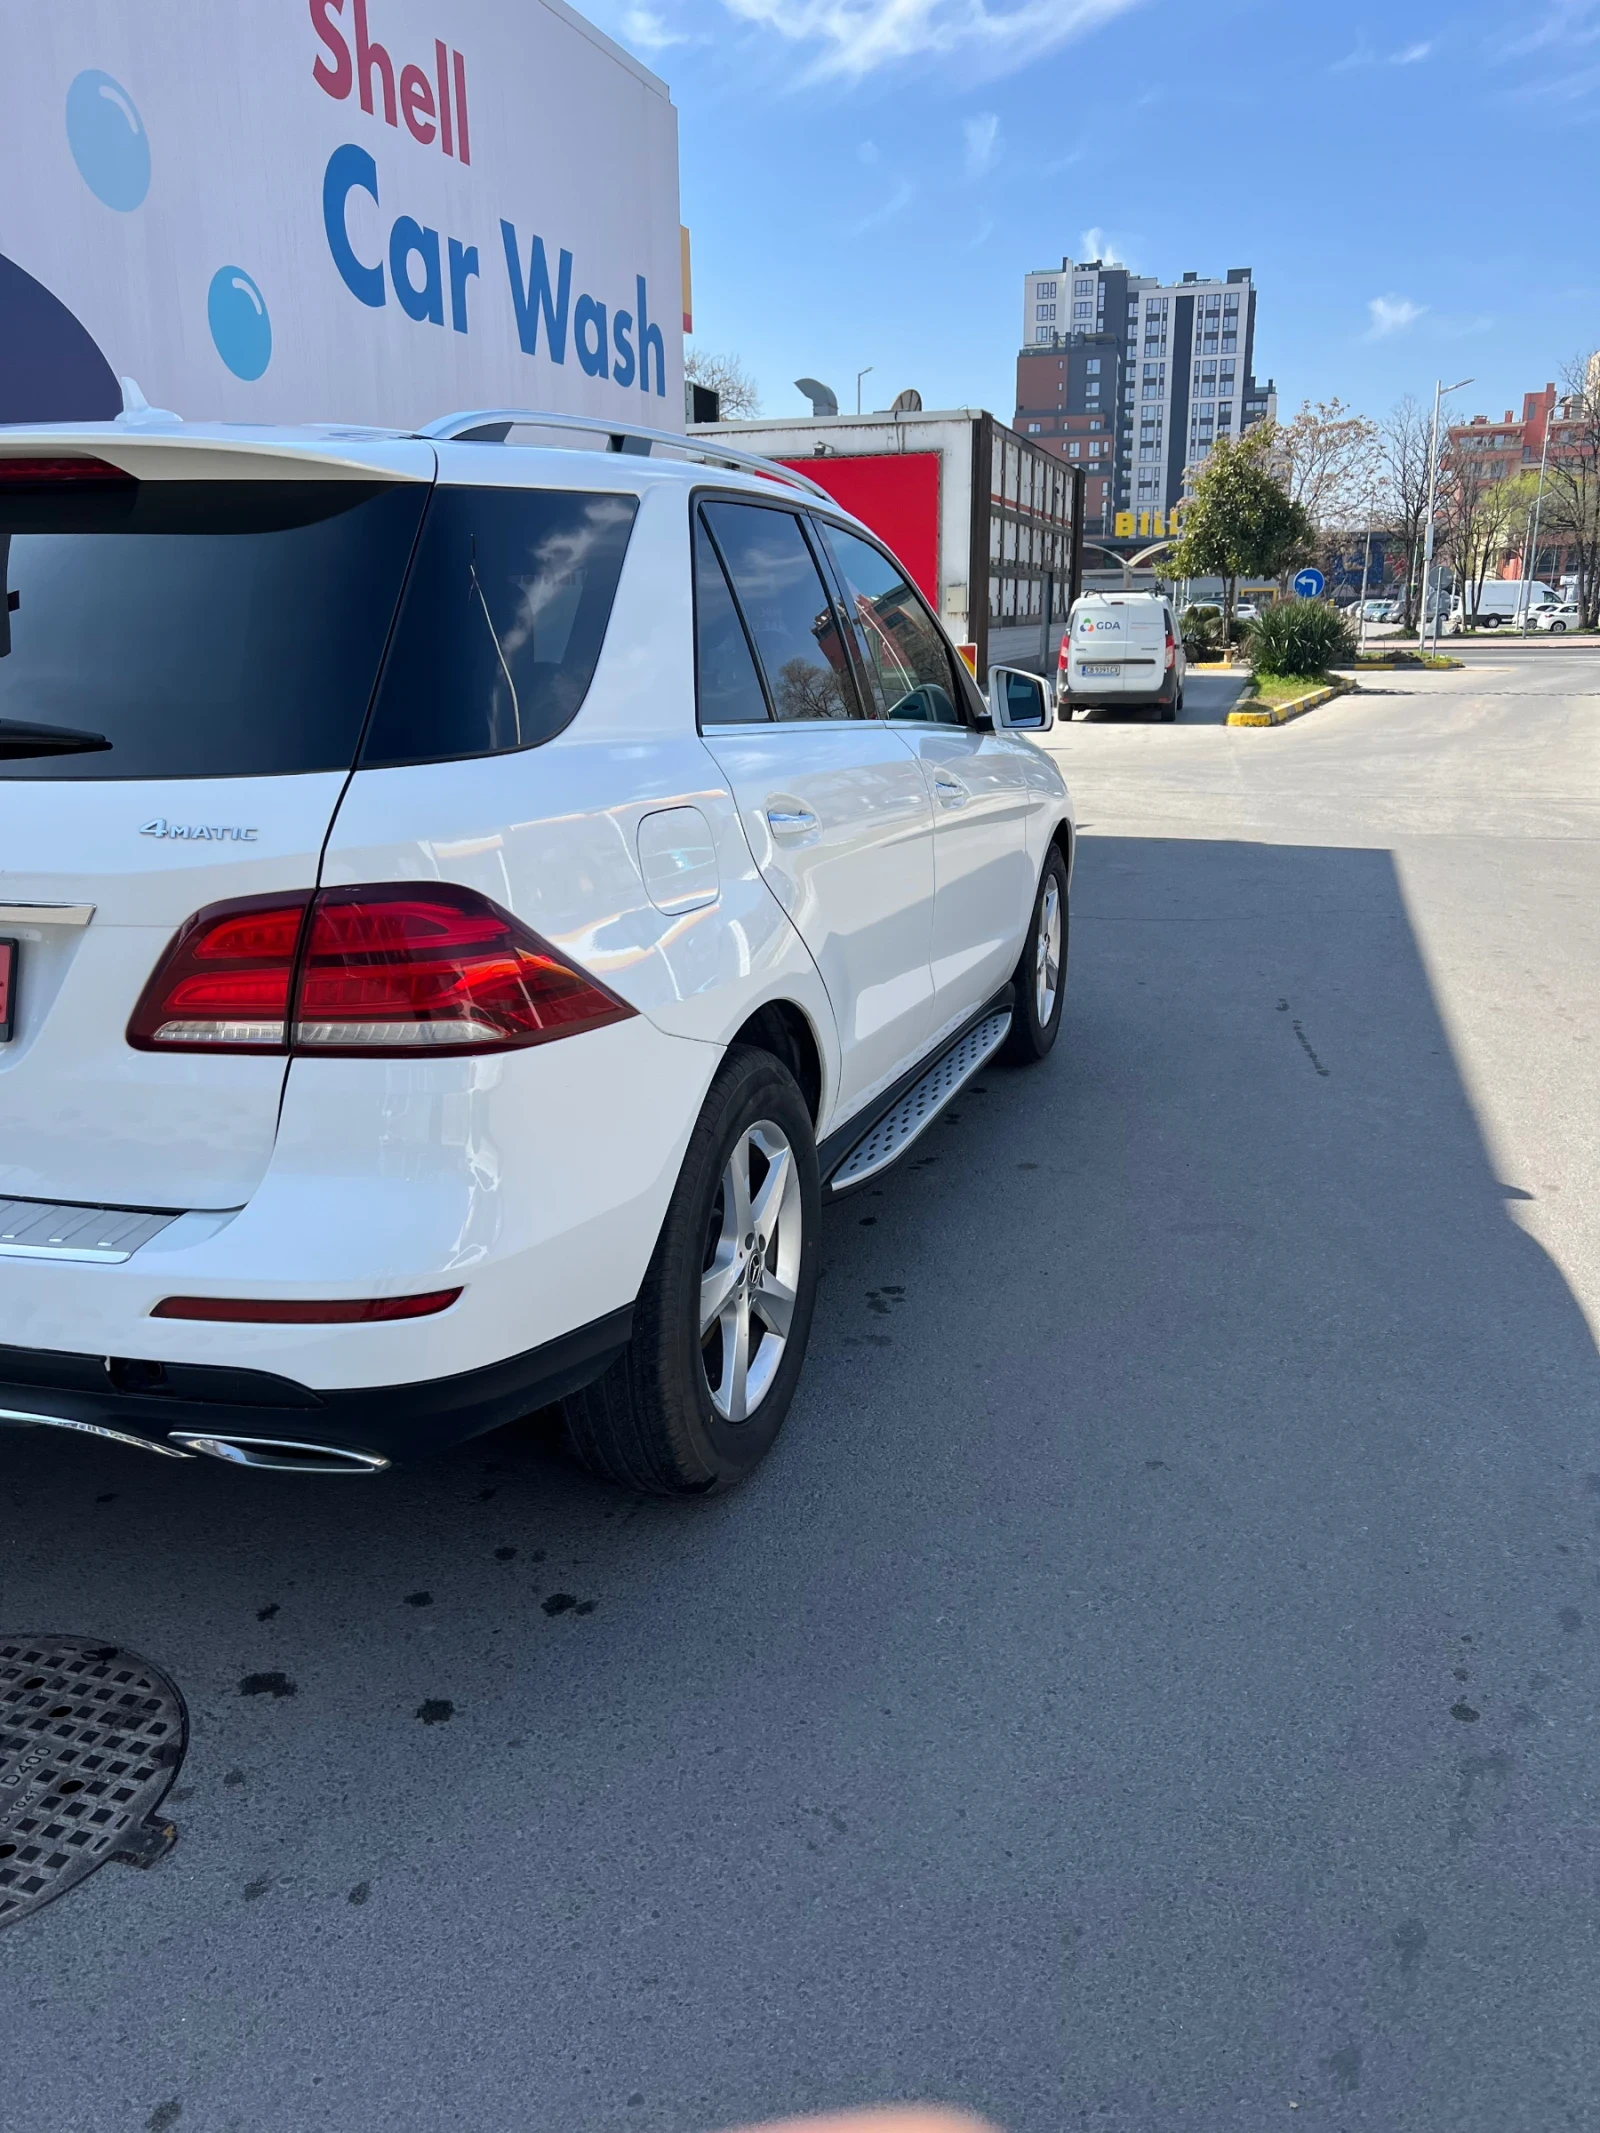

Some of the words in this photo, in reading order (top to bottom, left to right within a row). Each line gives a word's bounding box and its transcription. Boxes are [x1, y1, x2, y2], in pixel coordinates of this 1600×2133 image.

[311, 0, 471, 166] Shell
[322, 143, 479, 335] Car
[500, 218, 666, 397] Wash
[1096, 621, 1121, 630] GDA
[139, 818, 259, 841] 4MATIC
